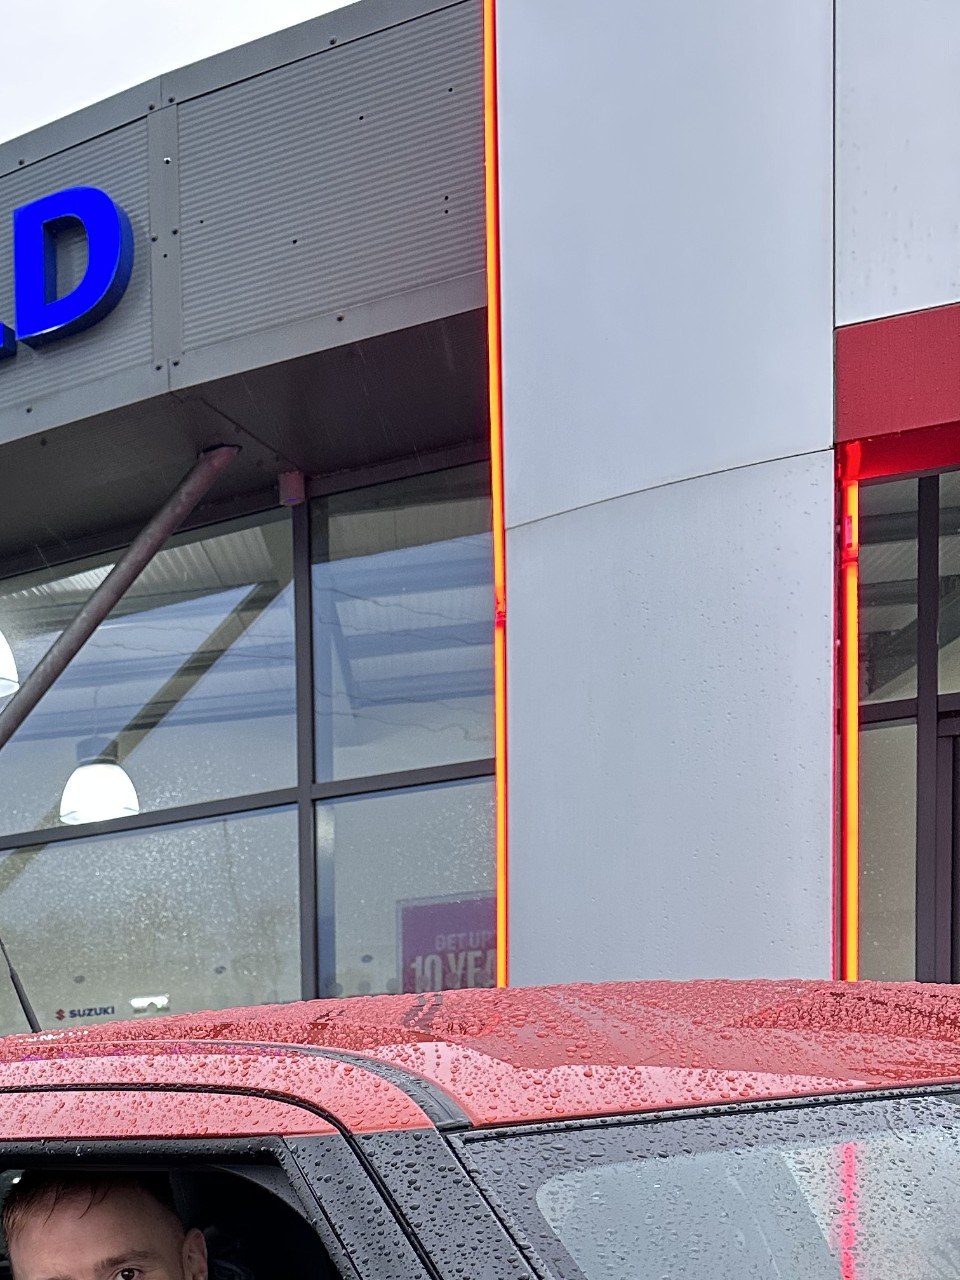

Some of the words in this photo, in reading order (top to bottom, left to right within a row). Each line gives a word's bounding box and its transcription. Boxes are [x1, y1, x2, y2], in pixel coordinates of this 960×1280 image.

[434, 932, 467, 951] GET
[410, 954, 443, 993] 10
[69, 1006, 115, 1018] SUZUKI
